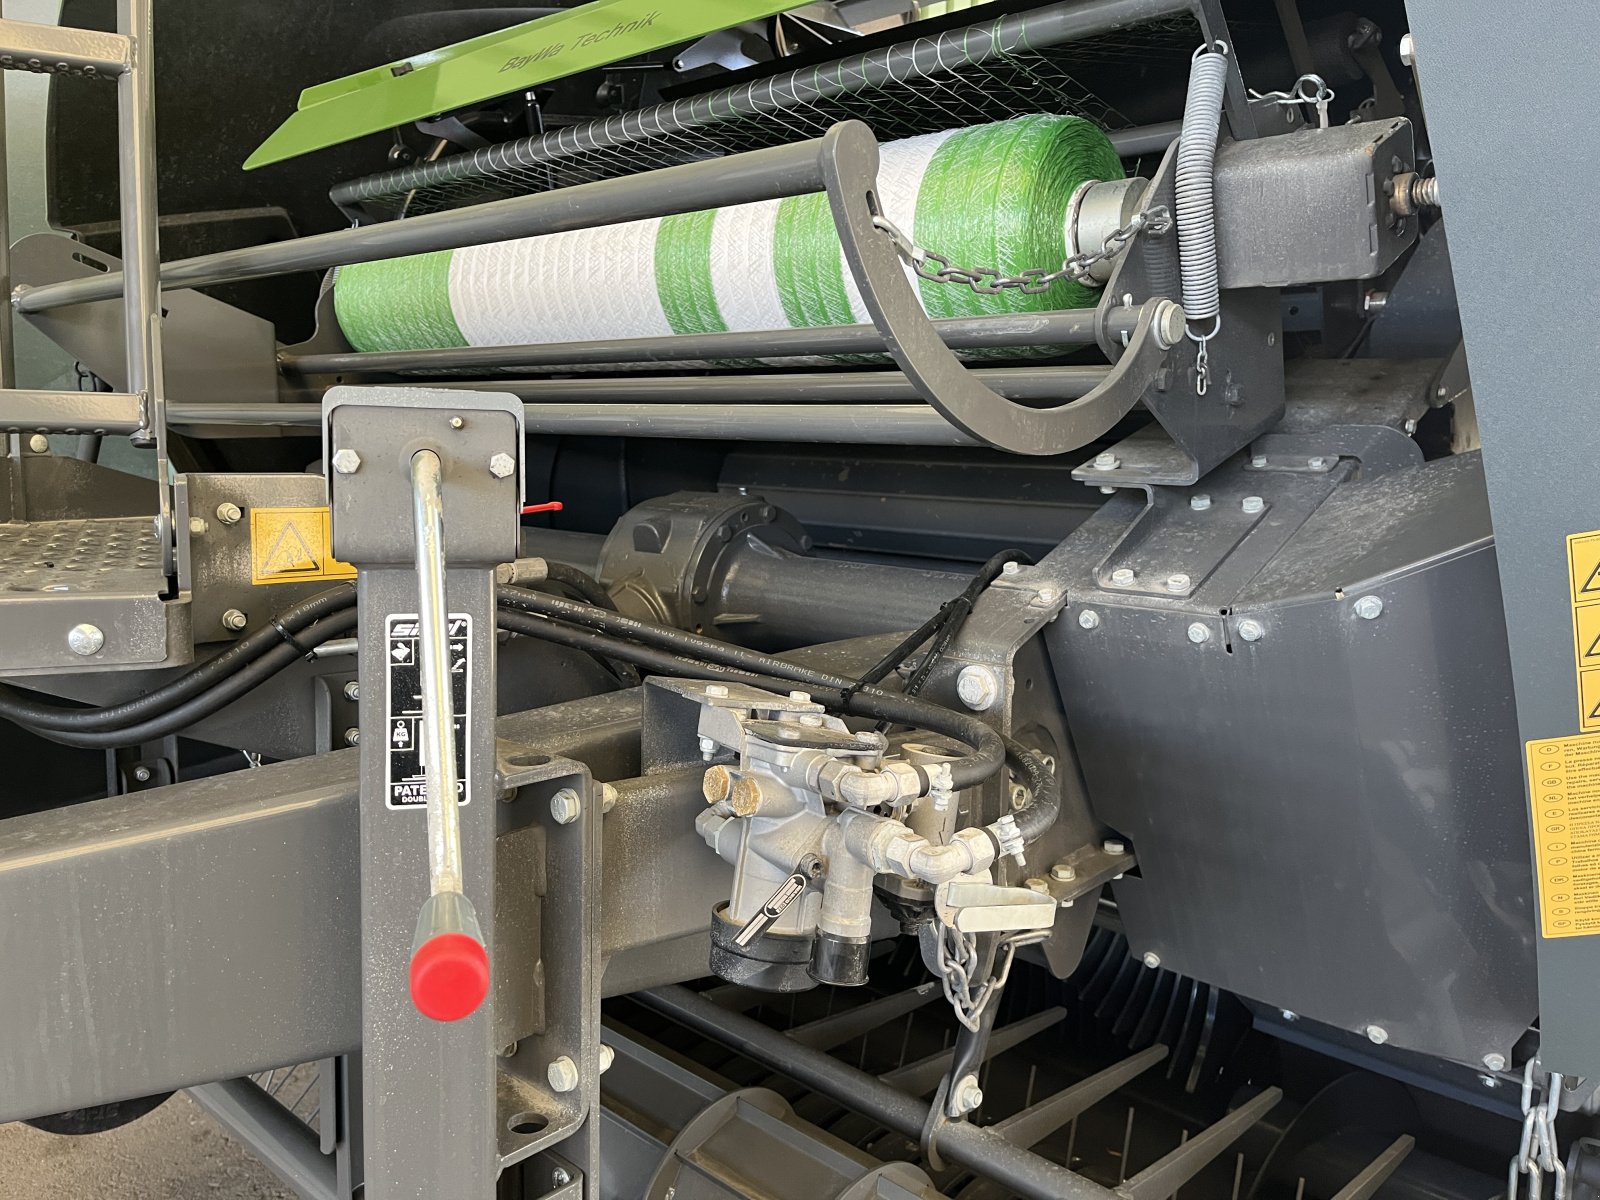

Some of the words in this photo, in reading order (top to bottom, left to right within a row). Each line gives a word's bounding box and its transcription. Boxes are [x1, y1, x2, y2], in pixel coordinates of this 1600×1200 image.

[497, 43, 565, 73] BayWa
[571, 10, 662, 50] Technik
[758, 656, 816, 678] AIRBRAKE
[821, 672, 844, 686] DIN
[848, 682, 884, 697] 7310
